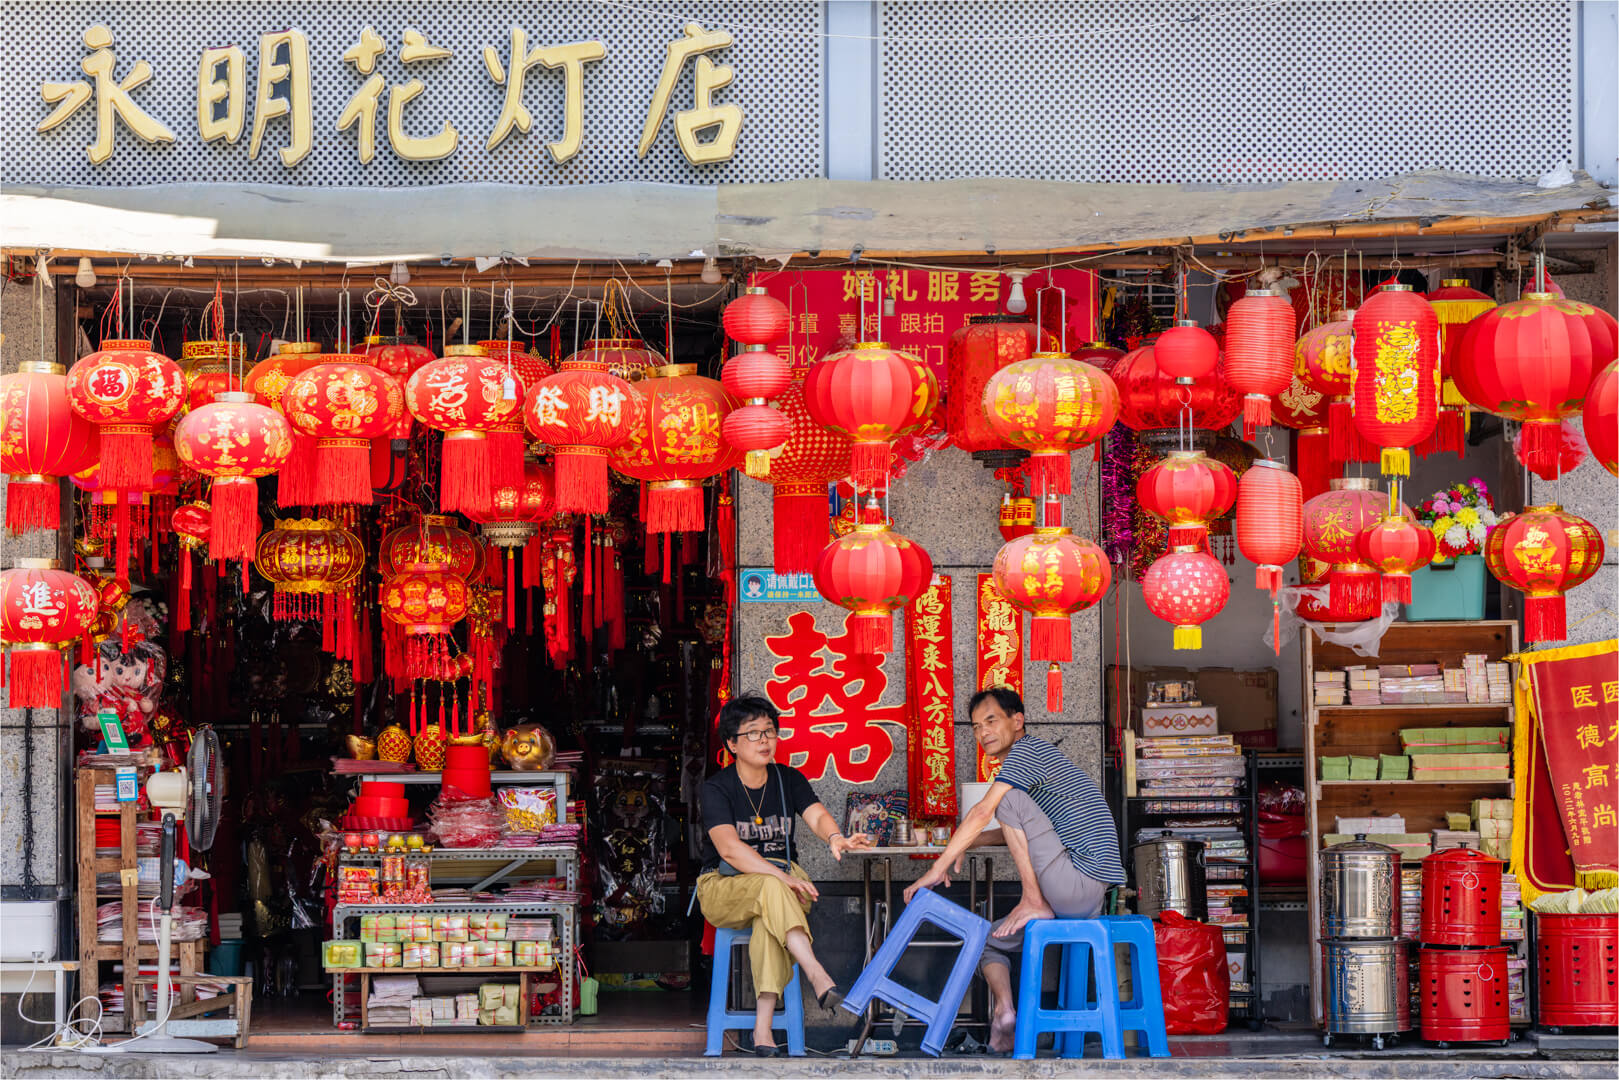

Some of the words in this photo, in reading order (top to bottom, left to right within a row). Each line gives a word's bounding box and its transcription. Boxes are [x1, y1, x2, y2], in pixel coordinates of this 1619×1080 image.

[38, 23, 745, 167] 永明花灯店
[842, 270, 1000, 302] 婚礼服务
[900, 313, 944, 334] 跟拍
[776, 345, 819, 365] 司仪
[92, 368, 125, 397] 福
[533, 385, 627, 428] 發財
[22, 581, 60, 616] 進
[1571, 684, 1617, 829] 医德高尚
